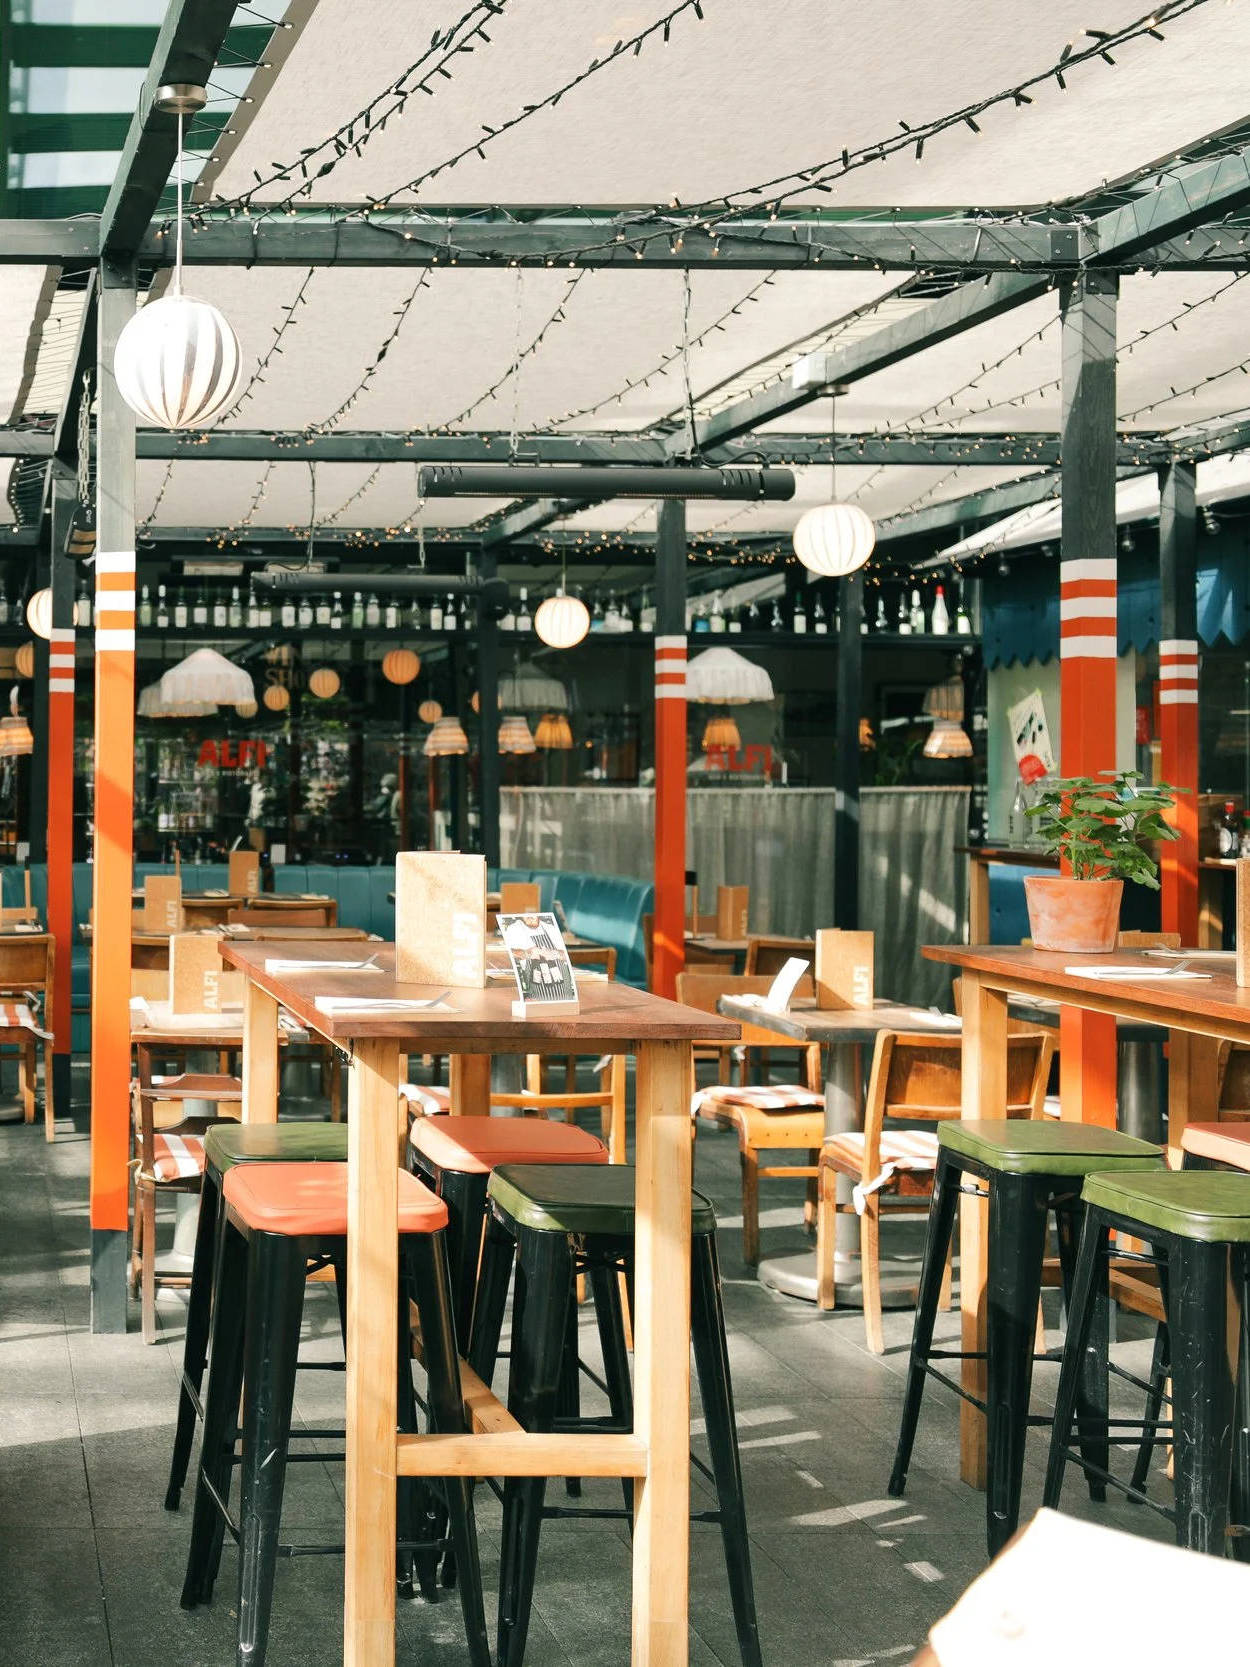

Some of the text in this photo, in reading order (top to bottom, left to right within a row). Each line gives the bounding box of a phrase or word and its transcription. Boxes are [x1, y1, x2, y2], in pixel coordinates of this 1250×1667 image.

[198, 738, 266, 768] ALFI
[704, 743, 773, 772] ALFI
[166, 900, 178, 928] ALFI
[452, 913, 479, 980] ALFI
[204, 970, 219, 1010] ALFI
[853, 965, 870, 1006] ALFI
